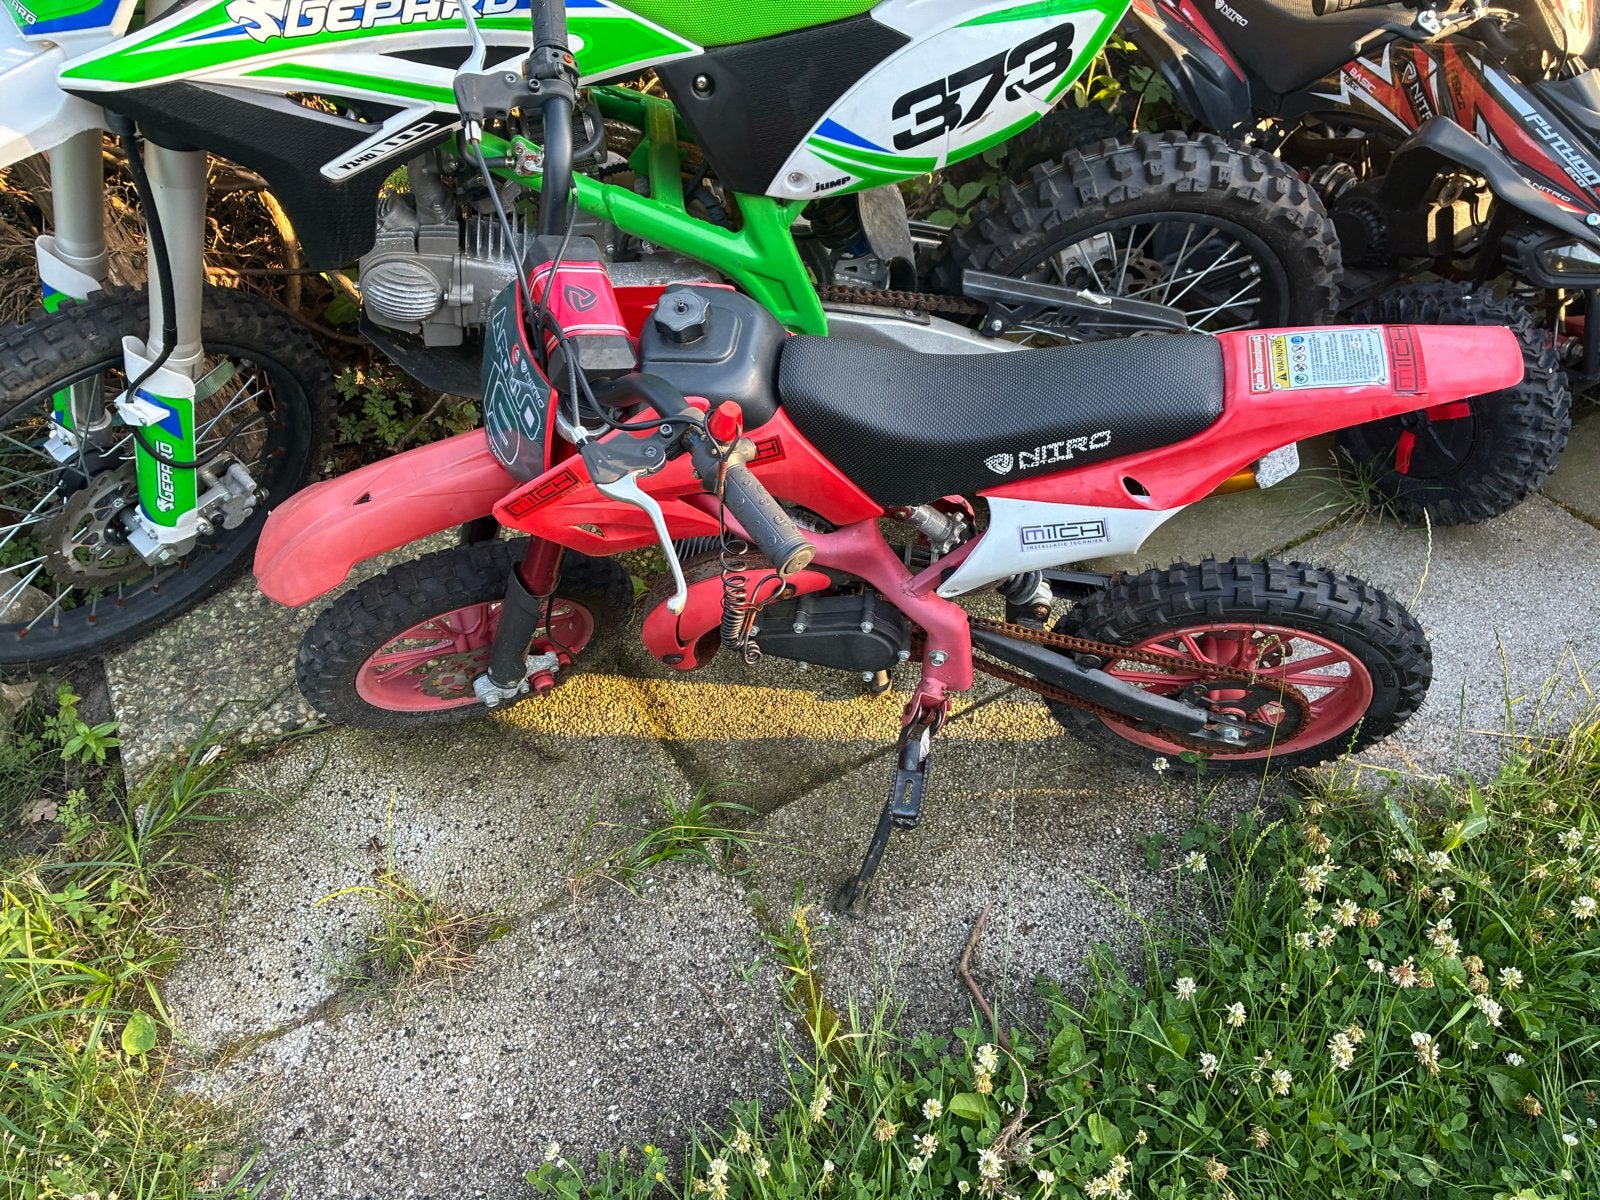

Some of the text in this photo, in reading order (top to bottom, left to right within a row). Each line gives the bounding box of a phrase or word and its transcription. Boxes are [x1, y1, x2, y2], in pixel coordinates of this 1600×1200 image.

[1220, 4, 1249, 27] NITRO
[892, 22, 1076, 151] 373
[1349, 67, 1377, 94] BASIC
[1410, 82, 1433, 120] NITR
[1524, 114, 1600, 186] PYTHON
[1532, 182, 1571, 202] NITRO
[1275, 340, 1285, 372] WARNUNG
[1018, 430, 1112, 463] NITRO
[1026, 538, 1103, 551] INSTALLATIE TECHNIEK
